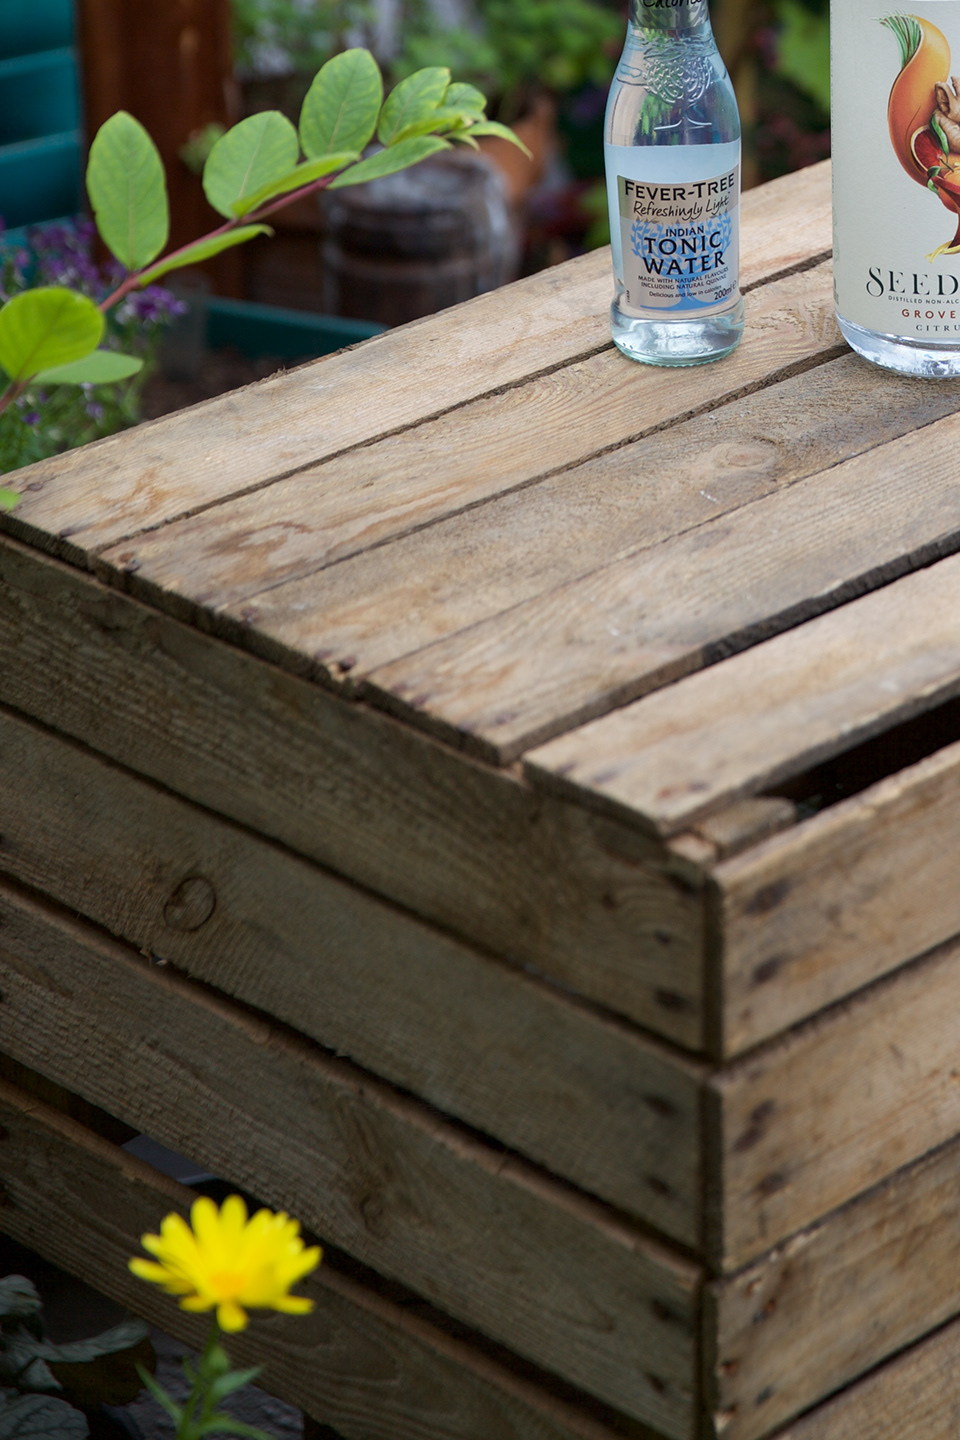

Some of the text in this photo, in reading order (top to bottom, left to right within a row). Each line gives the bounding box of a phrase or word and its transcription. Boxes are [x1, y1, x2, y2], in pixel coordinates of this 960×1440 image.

[624, 172, 735, 201] FEVER-TREE
[633, 195, 730, 220] Refreshingly Light
[665, 225, 705, 237] INDIAN
[644, 231, 721, 255] TONIC
[642, 251, 725, 276] WATER
[638, 275, 656, 283] MADE
[674, 276, 702, 284] NATURAL
[704, 266, 729, 279] FLAVOURS
[641, 274, 727, 290] INCLUDING NATURAL QUININE
[686, 290, 697, 298] low
[704, 285, 722, 294] calories
[888, 295, 923, 304] DISTILLED
[901, 308, 956, 319] GROVE
